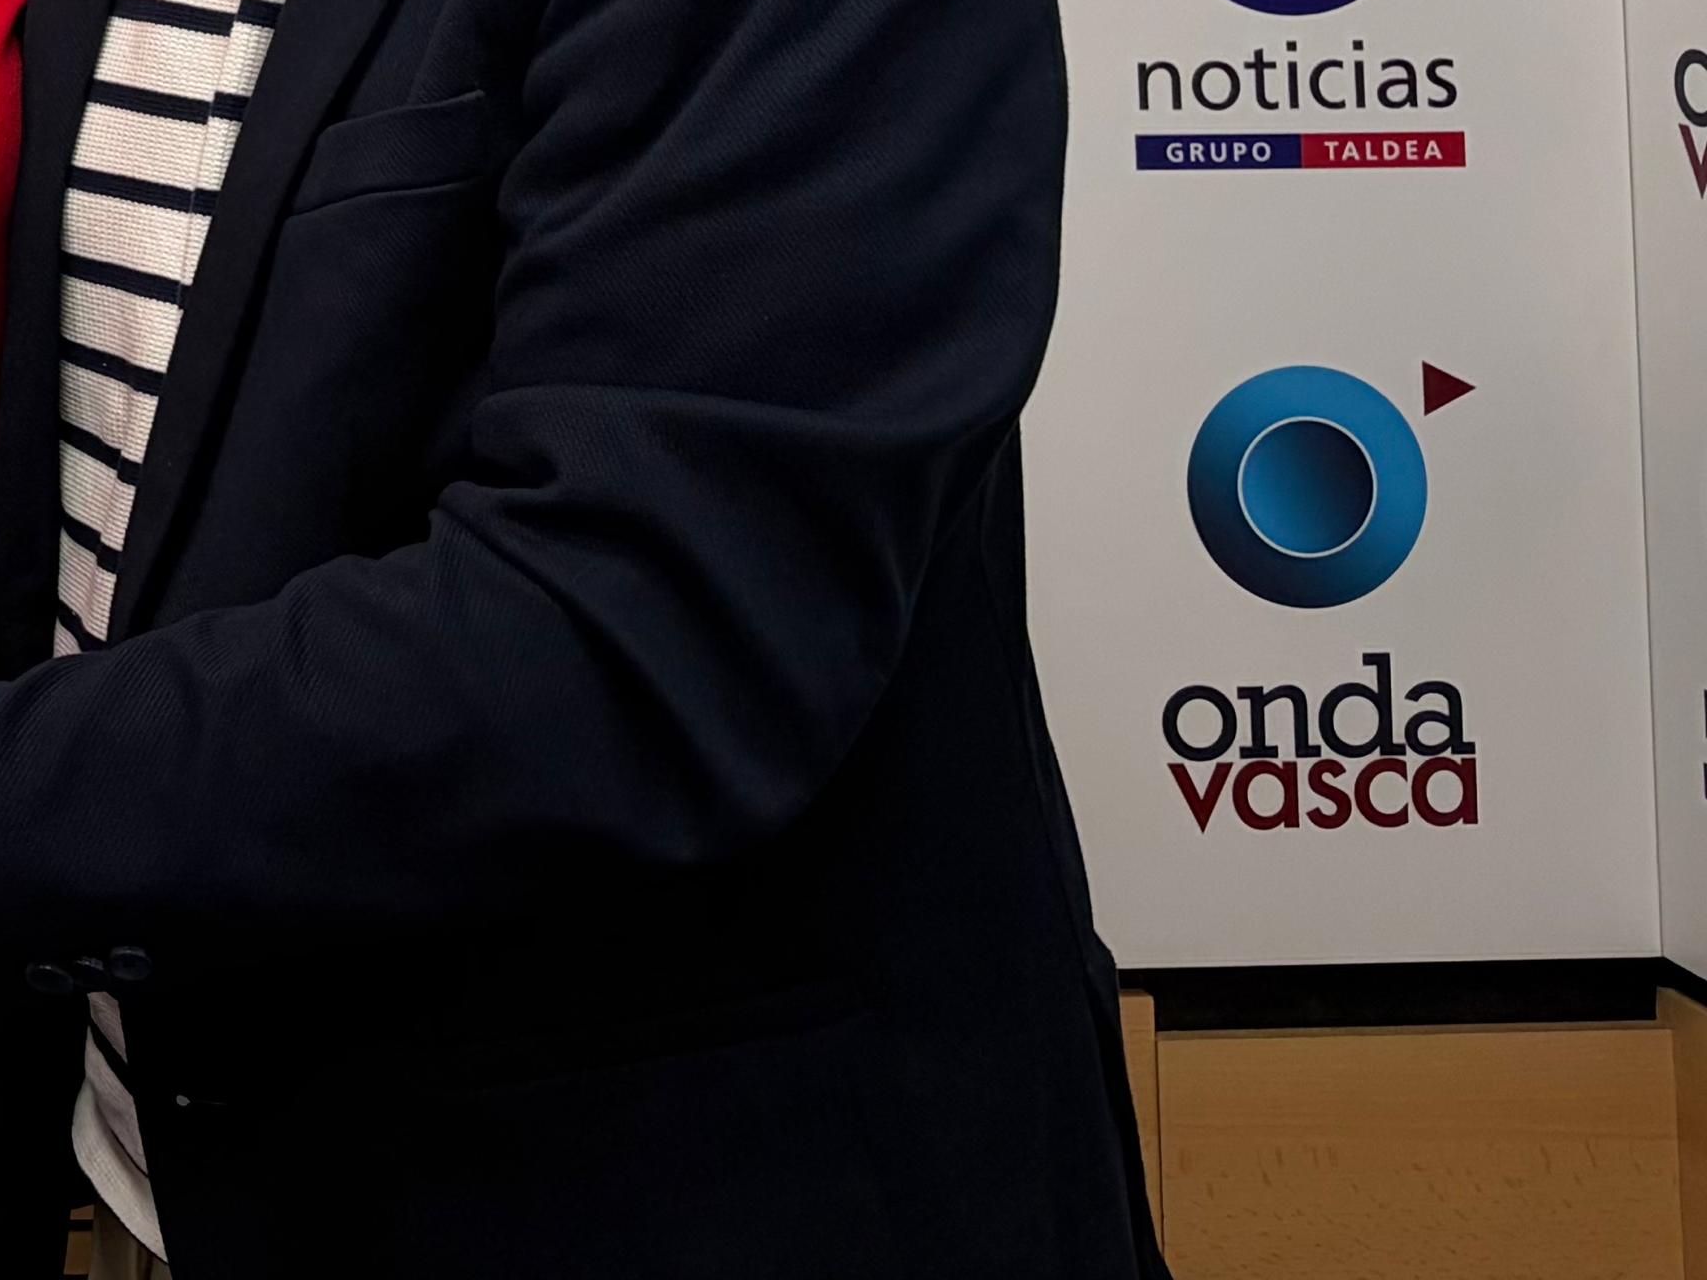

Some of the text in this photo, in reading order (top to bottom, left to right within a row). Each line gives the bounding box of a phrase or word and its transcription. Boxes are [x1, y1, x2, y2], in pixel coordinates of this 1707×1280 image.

[1137, 40, 1457, 110] noticias
[1165, 139, 1443, 163] GRUPO TALDEA
[1162, 652, 1476, 762] onda
[1167, 757, 1479, 835] vasca
